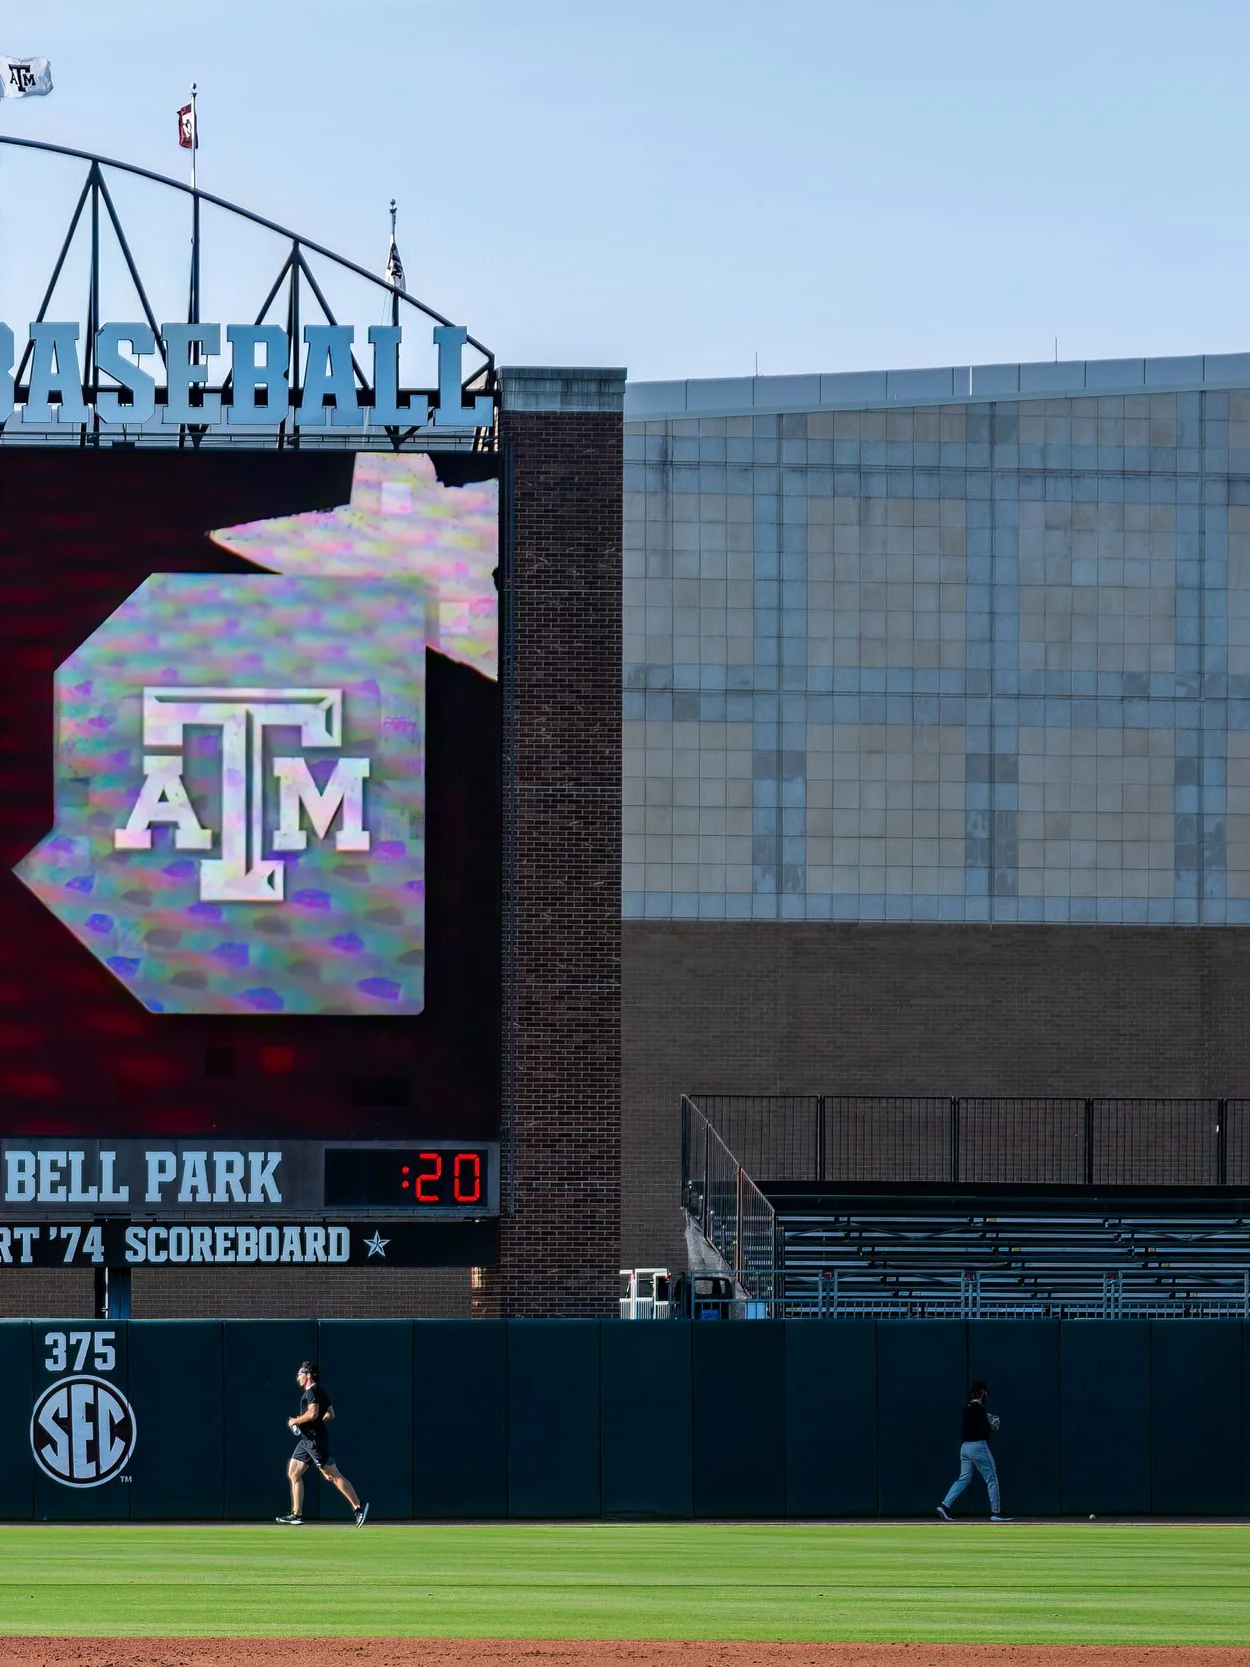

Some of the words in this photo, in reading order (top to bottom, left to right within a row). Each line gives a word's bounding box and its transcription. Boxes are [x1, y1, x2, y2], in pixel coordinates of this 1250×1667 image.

[5, 1151, 129, 1202] BELL
[144, 1151, 283, 1202] PARK
[49, 1227, 105, 1263] '74
[125, 1227, 350, 1263] SCOREBOARD
[44, 1331, 116, 1372] 375
[37, 1383, 126, 1479] SEC
